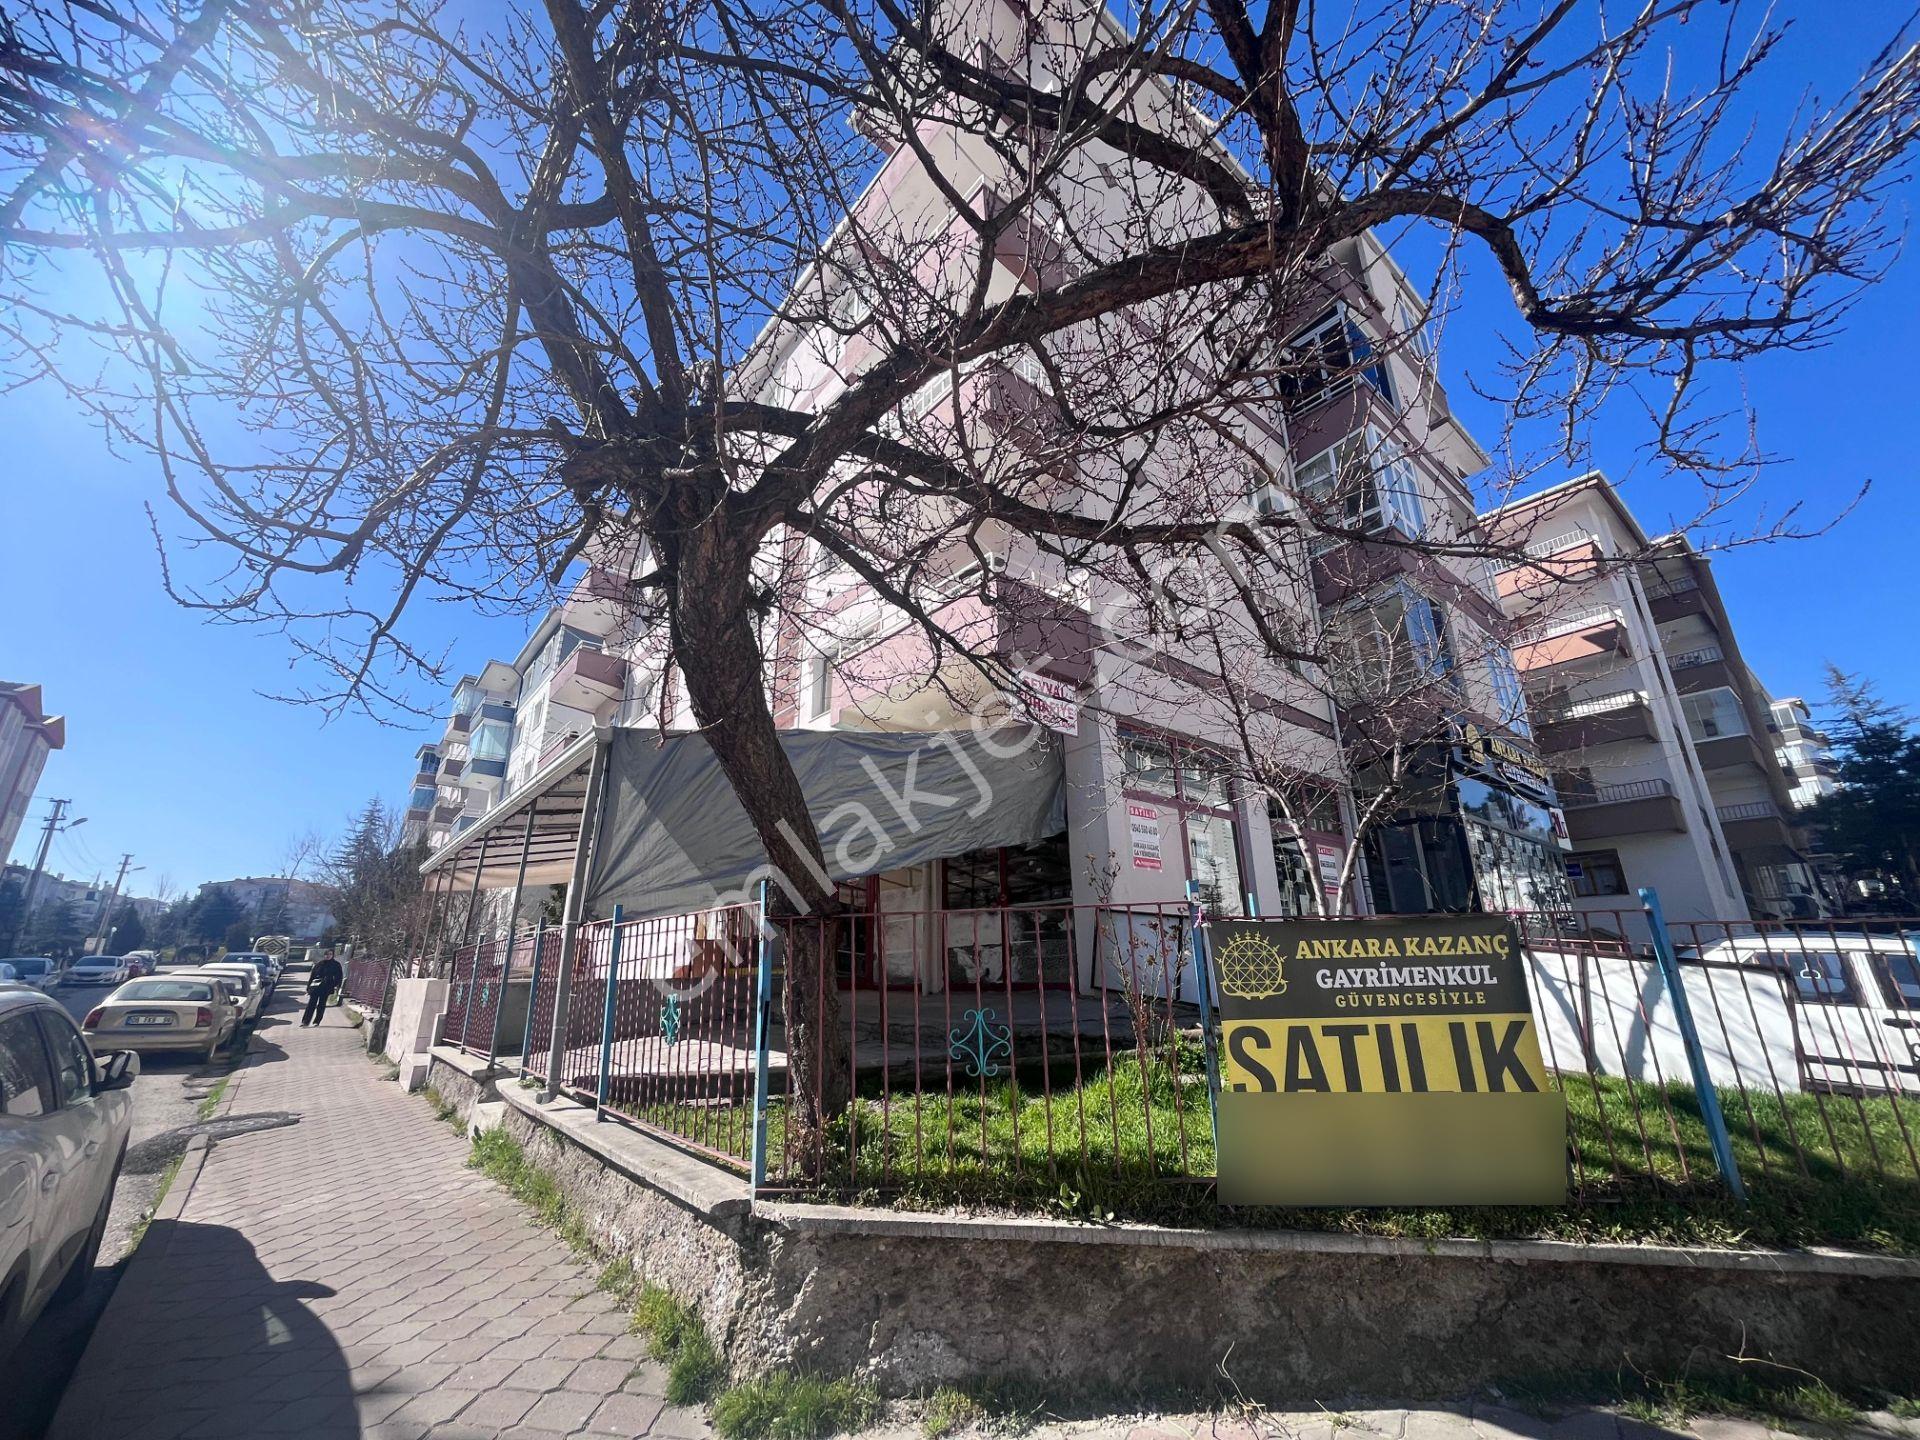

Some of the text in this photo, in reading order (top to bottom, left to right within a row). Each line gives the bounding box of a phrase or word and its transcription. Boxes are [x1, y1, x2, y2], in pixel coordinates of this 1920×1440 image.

[1295, 934, 1510, 960] ANKARA KAZANÇ
[1315, 961, 1497, 989] GAYRİMENKUL
[1335, 988, 1487, 1008] GÜVENCESİYLE
[1228, 1020, 1540, 1092] SATILIK
